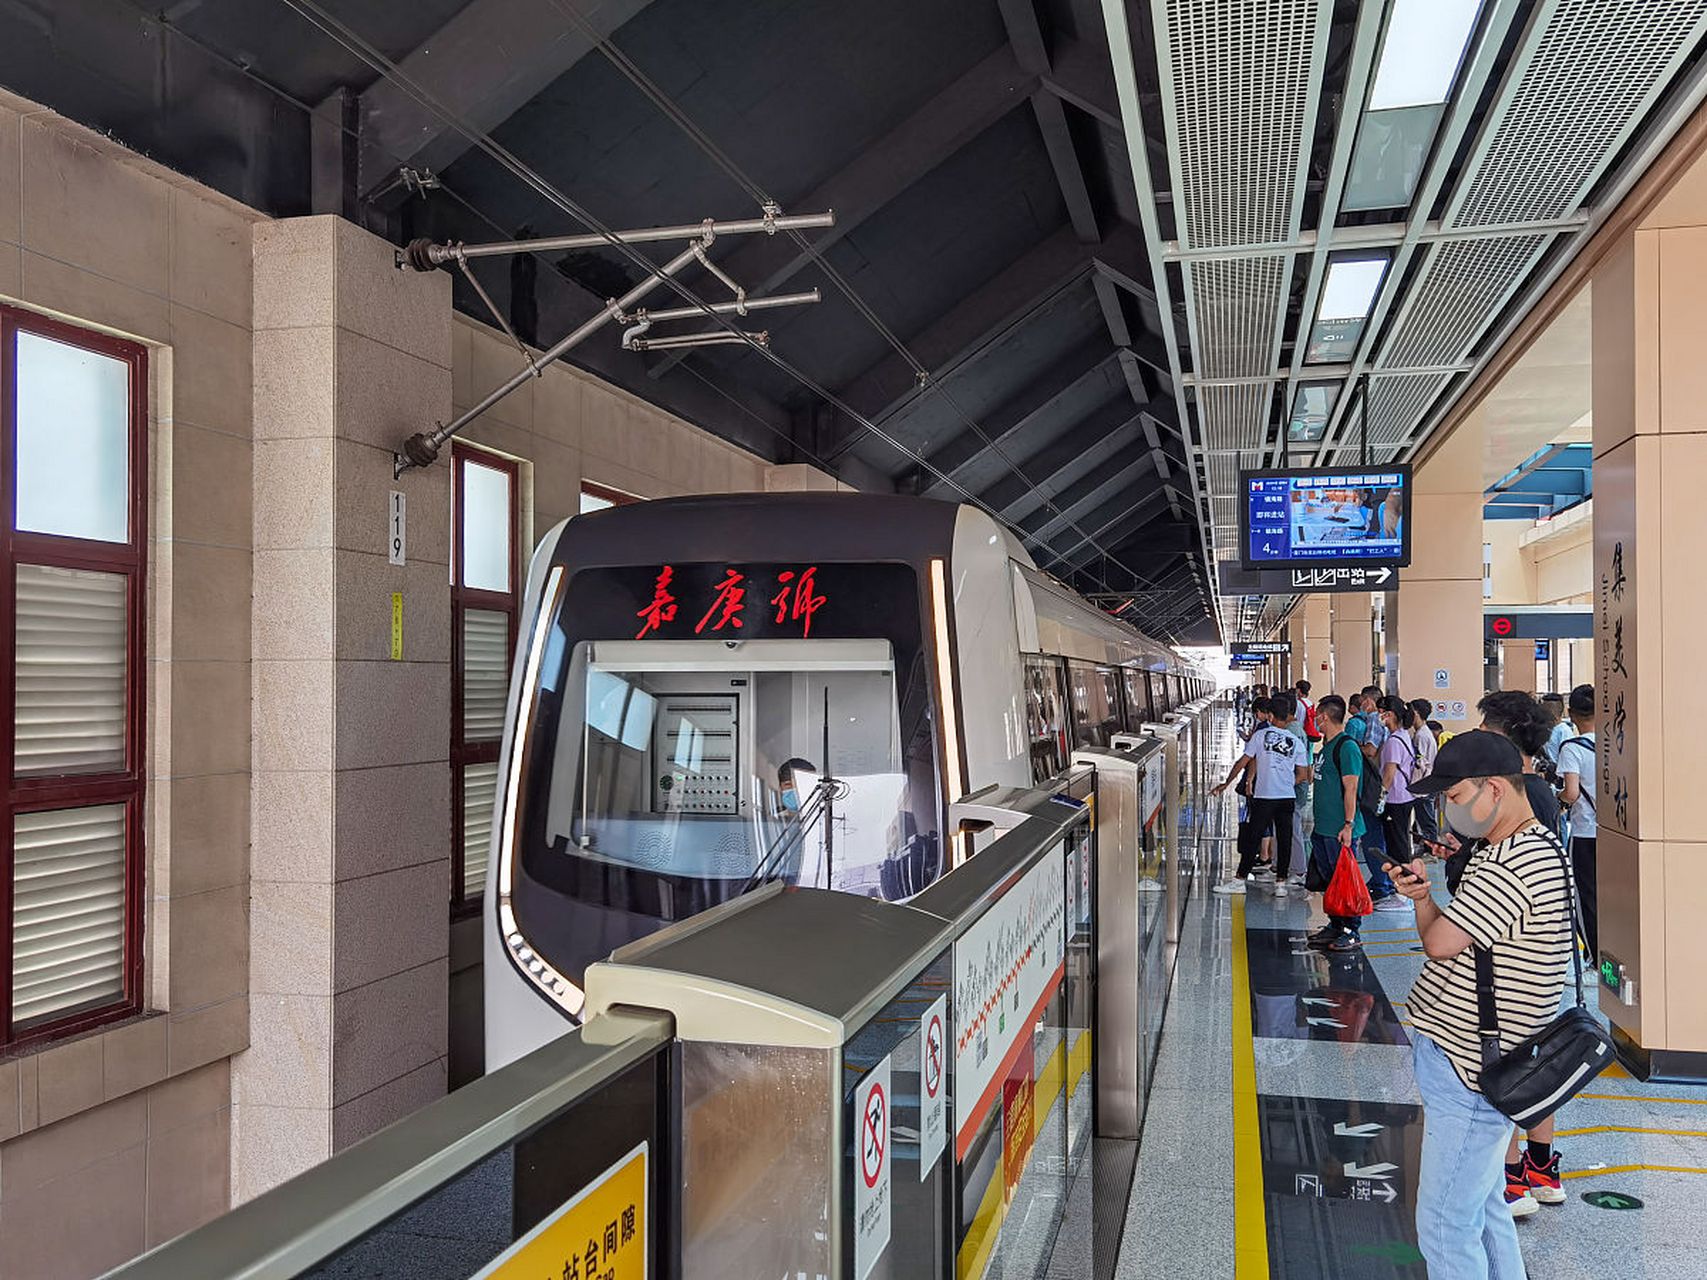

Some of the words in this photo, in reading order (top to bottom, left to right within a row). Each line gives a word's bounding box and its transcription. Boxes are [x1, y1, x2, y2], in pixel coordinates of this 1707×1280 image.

[393, 494, 402, 558] 119
[1262, 542, 1271, 553] 4
[1601, 638, 1611, 713] School
[1602, 721, 1612, 796] Village
